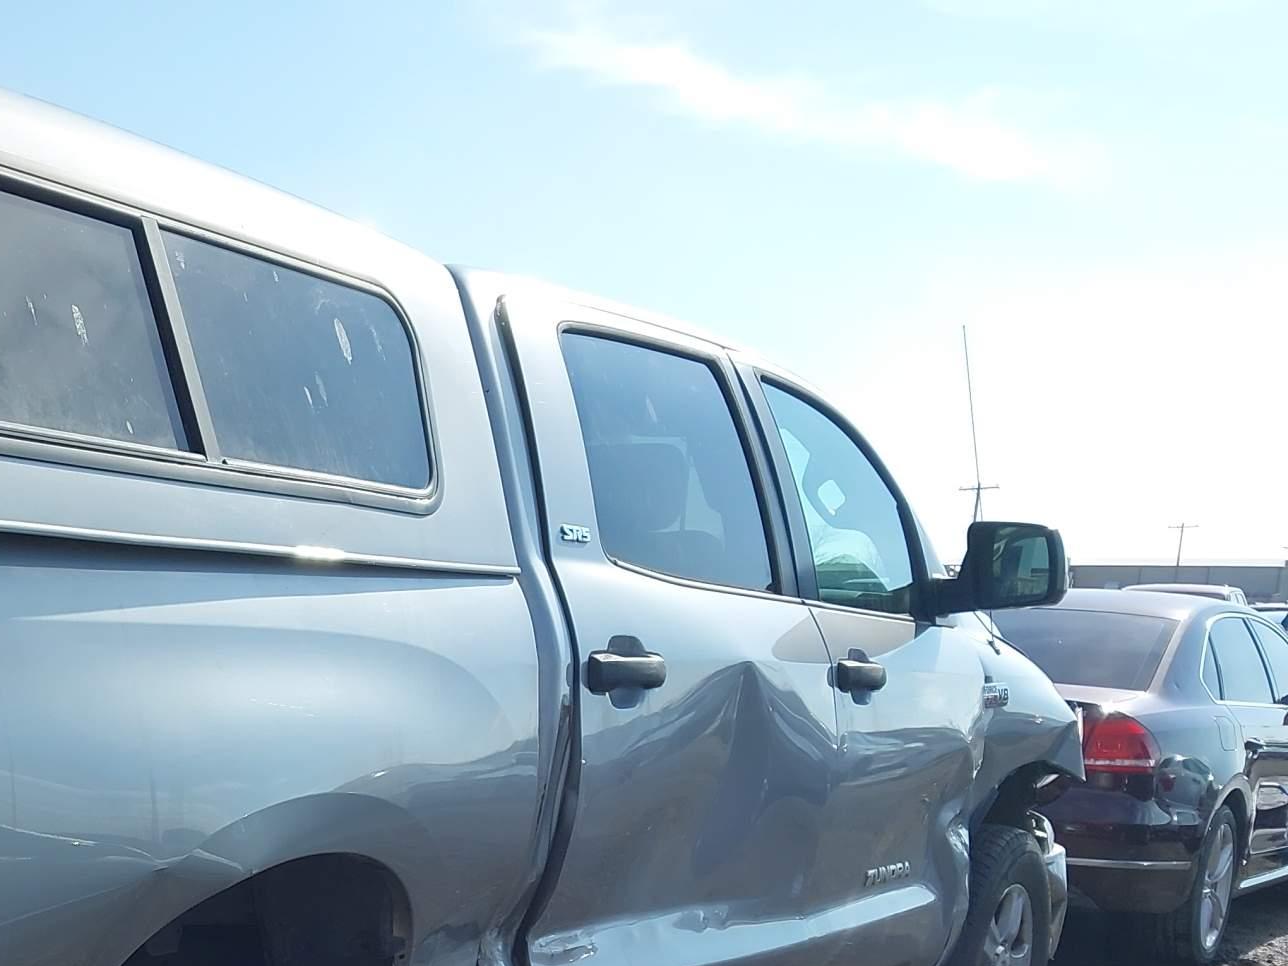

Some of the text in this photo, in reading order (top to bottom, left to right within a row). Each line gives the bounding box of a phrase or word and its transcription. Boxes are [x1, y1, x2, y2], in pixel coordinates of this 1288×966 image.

[559, 523, 592, 543] SR5
[998, 688, 1010, 702] V8
[864, 861, 911, 887] TUNDRA
